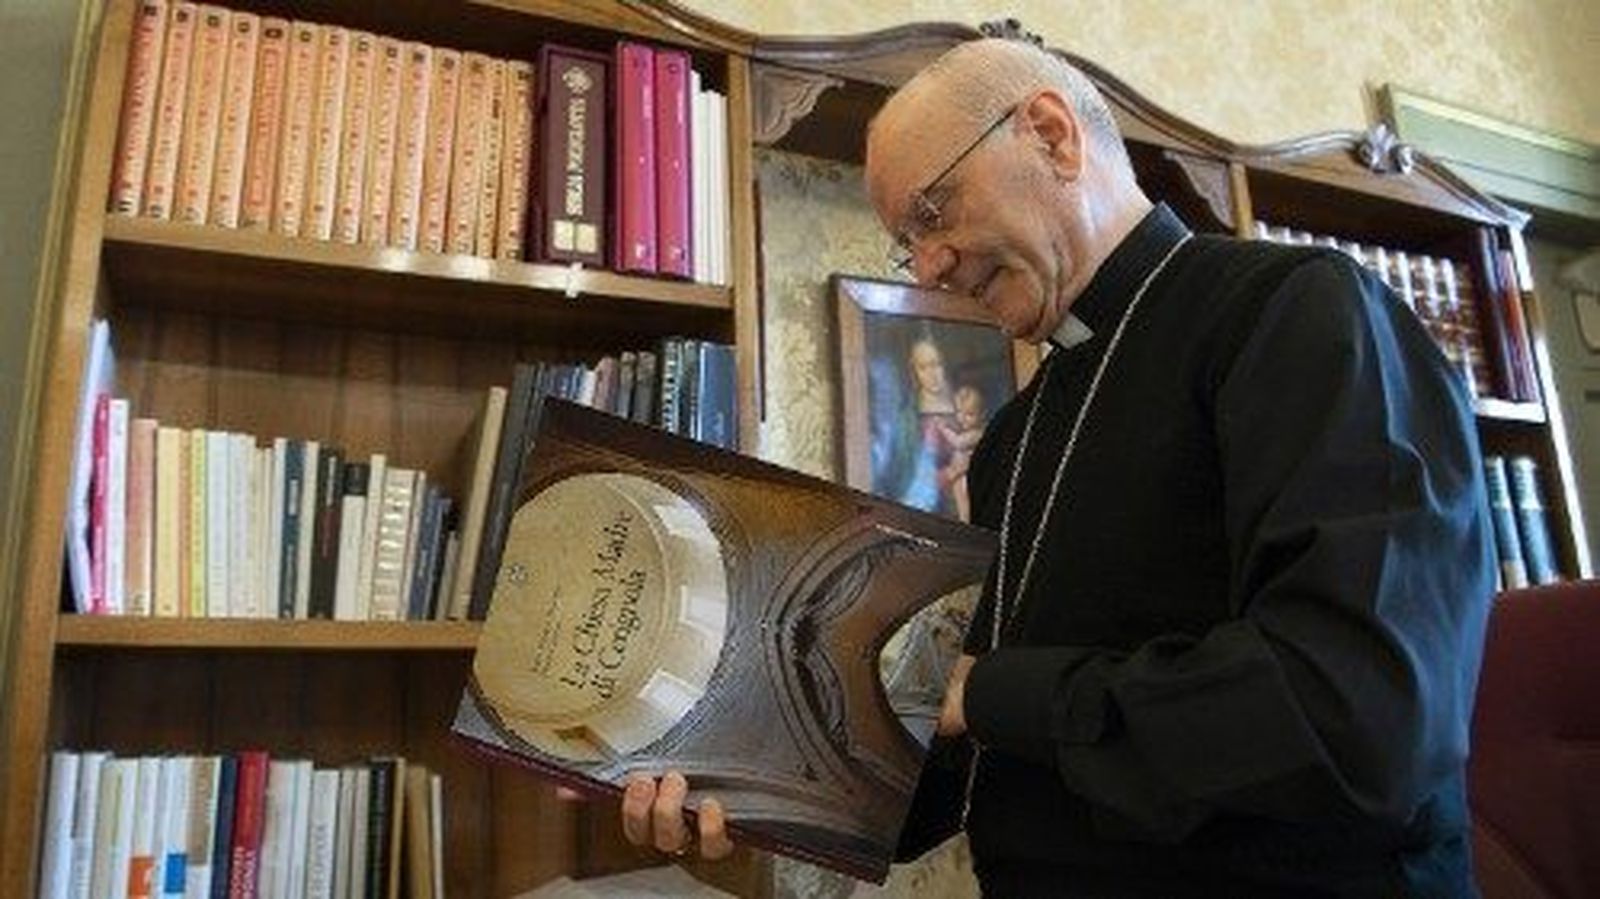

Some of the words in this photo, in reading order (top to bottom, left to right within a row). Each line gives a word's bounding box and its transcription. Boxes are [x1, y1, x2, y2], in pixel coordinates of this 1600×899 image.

[592, 510, 634, 581] Madre
[572, 587, 612, 656] Chiesa
[560, 661, 589, 689] La
[590, 673, 616, 700] di
